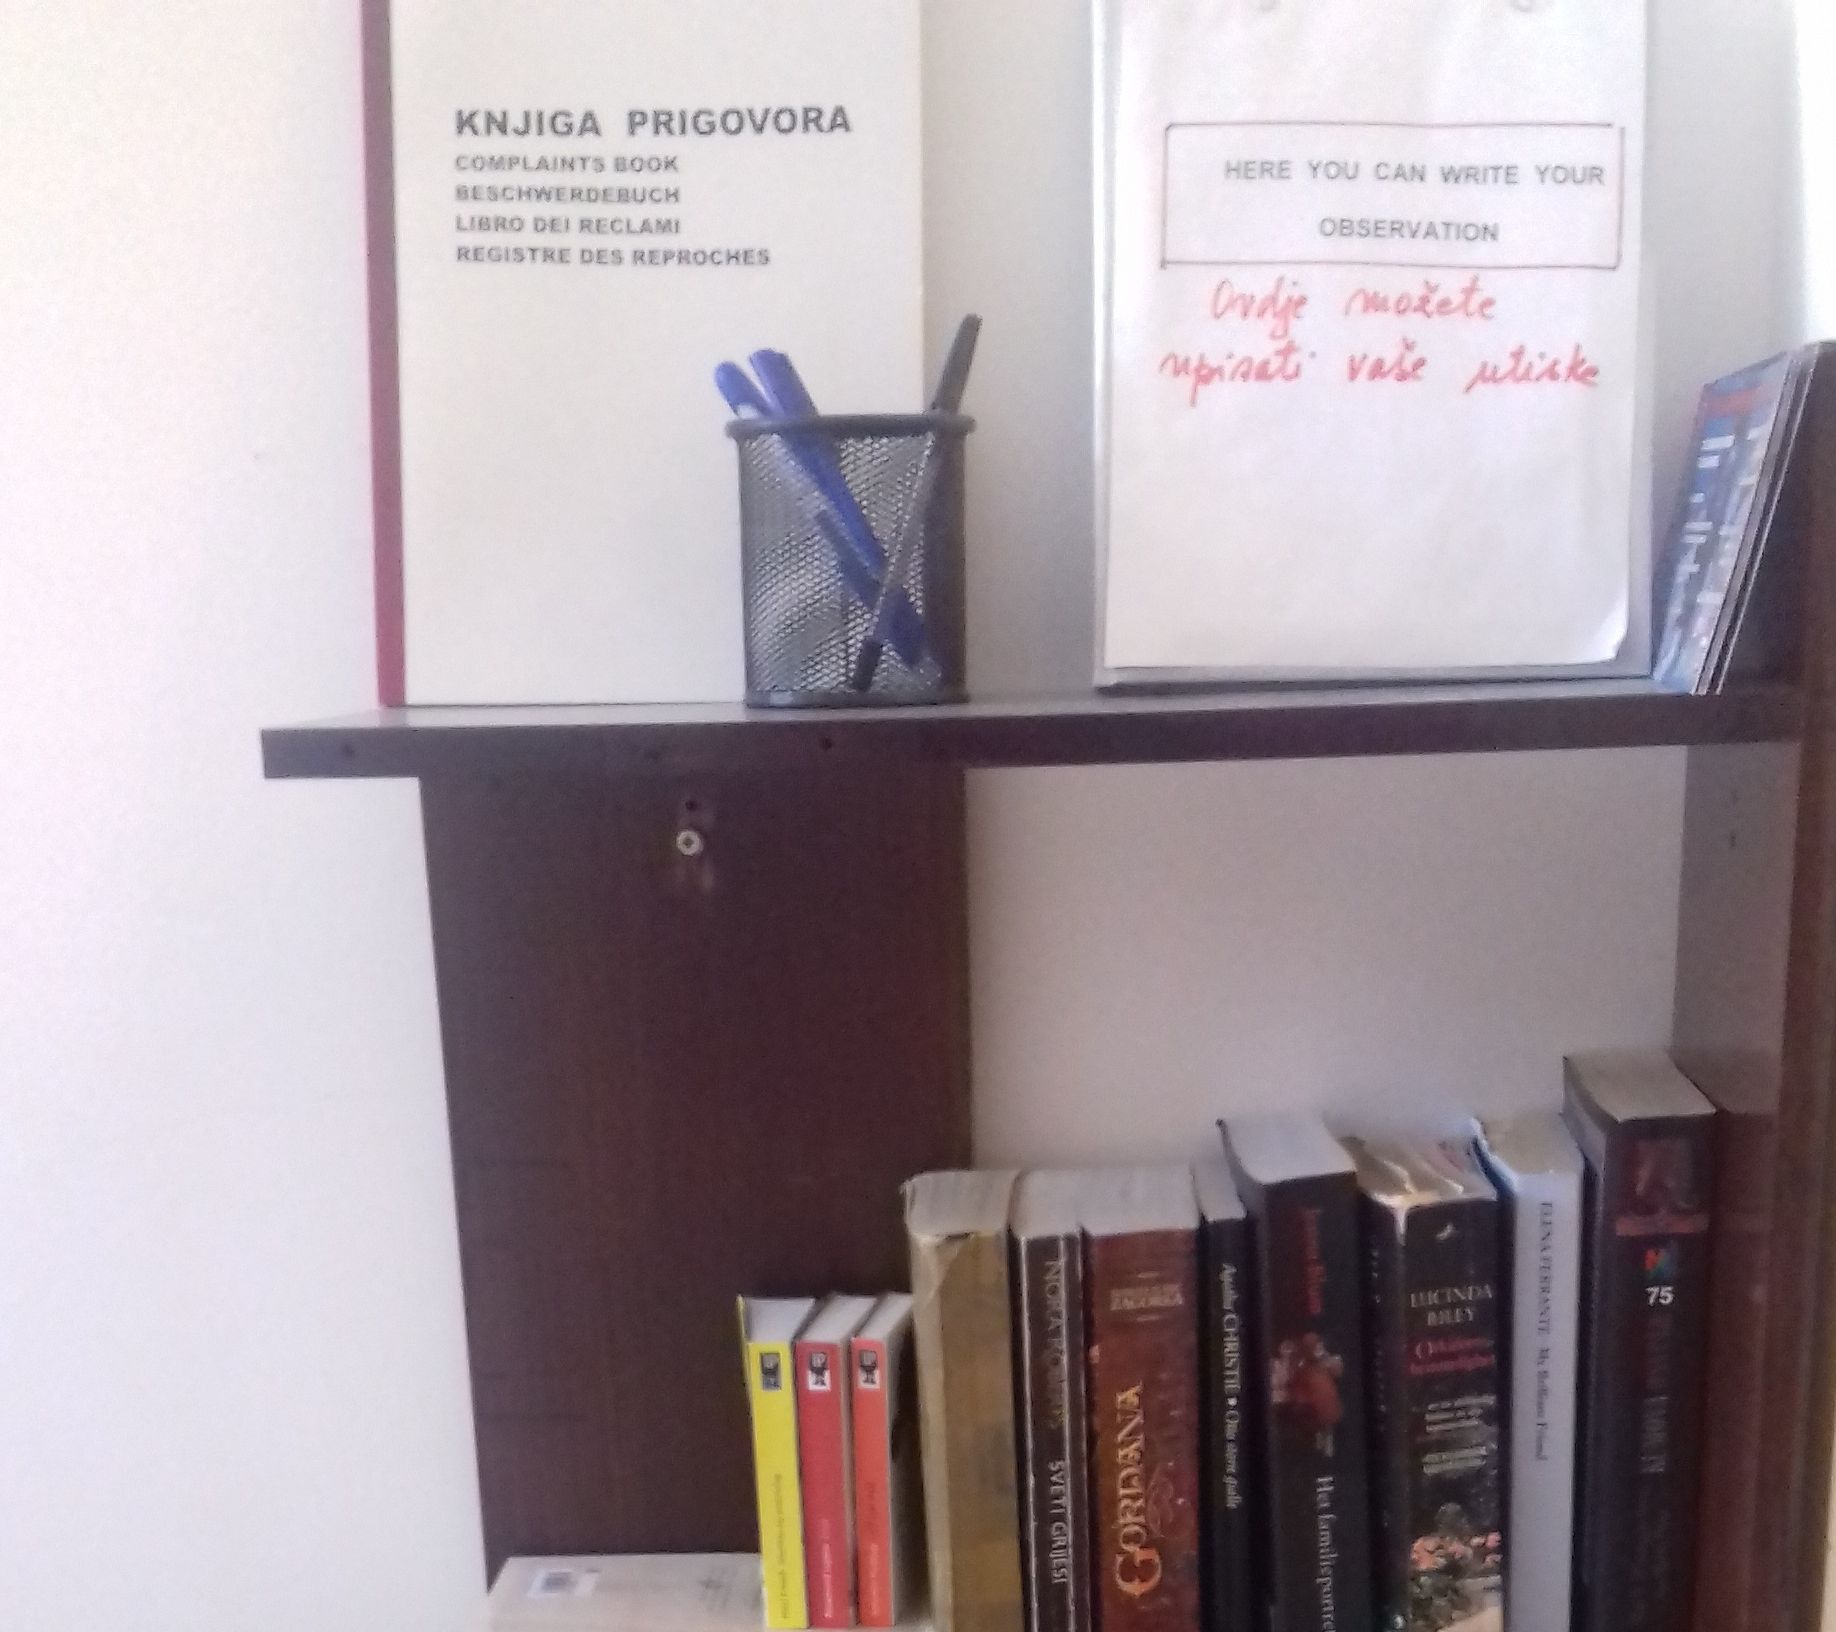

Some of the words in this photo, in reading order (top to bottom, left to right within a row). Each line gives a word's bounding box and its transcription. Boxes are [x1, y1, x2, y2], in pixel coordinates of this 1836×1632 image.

[455, 109, 602, 138] KNJIGA
[626, 106, 852, 136] PRIGOVORA
[455, 155, 606, 173] COMPLAINTS
[614, 155, 680, 173] BOOK
[1225, 160, 1292, 182] HERE
[1308, 161, 1360, 182] YOU
[1374, 162, 1426, 183] CAN
[1440, 164, 1519, 185] WRITE
[1535, 164, 1605, 186] YOUR
[455, 185, 681, 203] BESCHWERDEBUCH
[455, 216, 525, 234] LIBRO
[533, 217, 570, 234] DEI
[579, 217, 681, 235] RECLAMI
[1318, 217, 1499, 242] OBSERVATION
[456, 247, 571, 264] REGISTRE
[579, 248, 623, 265] DES
[632, 248, 770, 266] REPROCHES
[1645, 1285, 1675, 1306] 75
[1222, 1313, 1241, 1394] CHRISTIE
[1115, 1380, 1163, 1598] GORDANA
